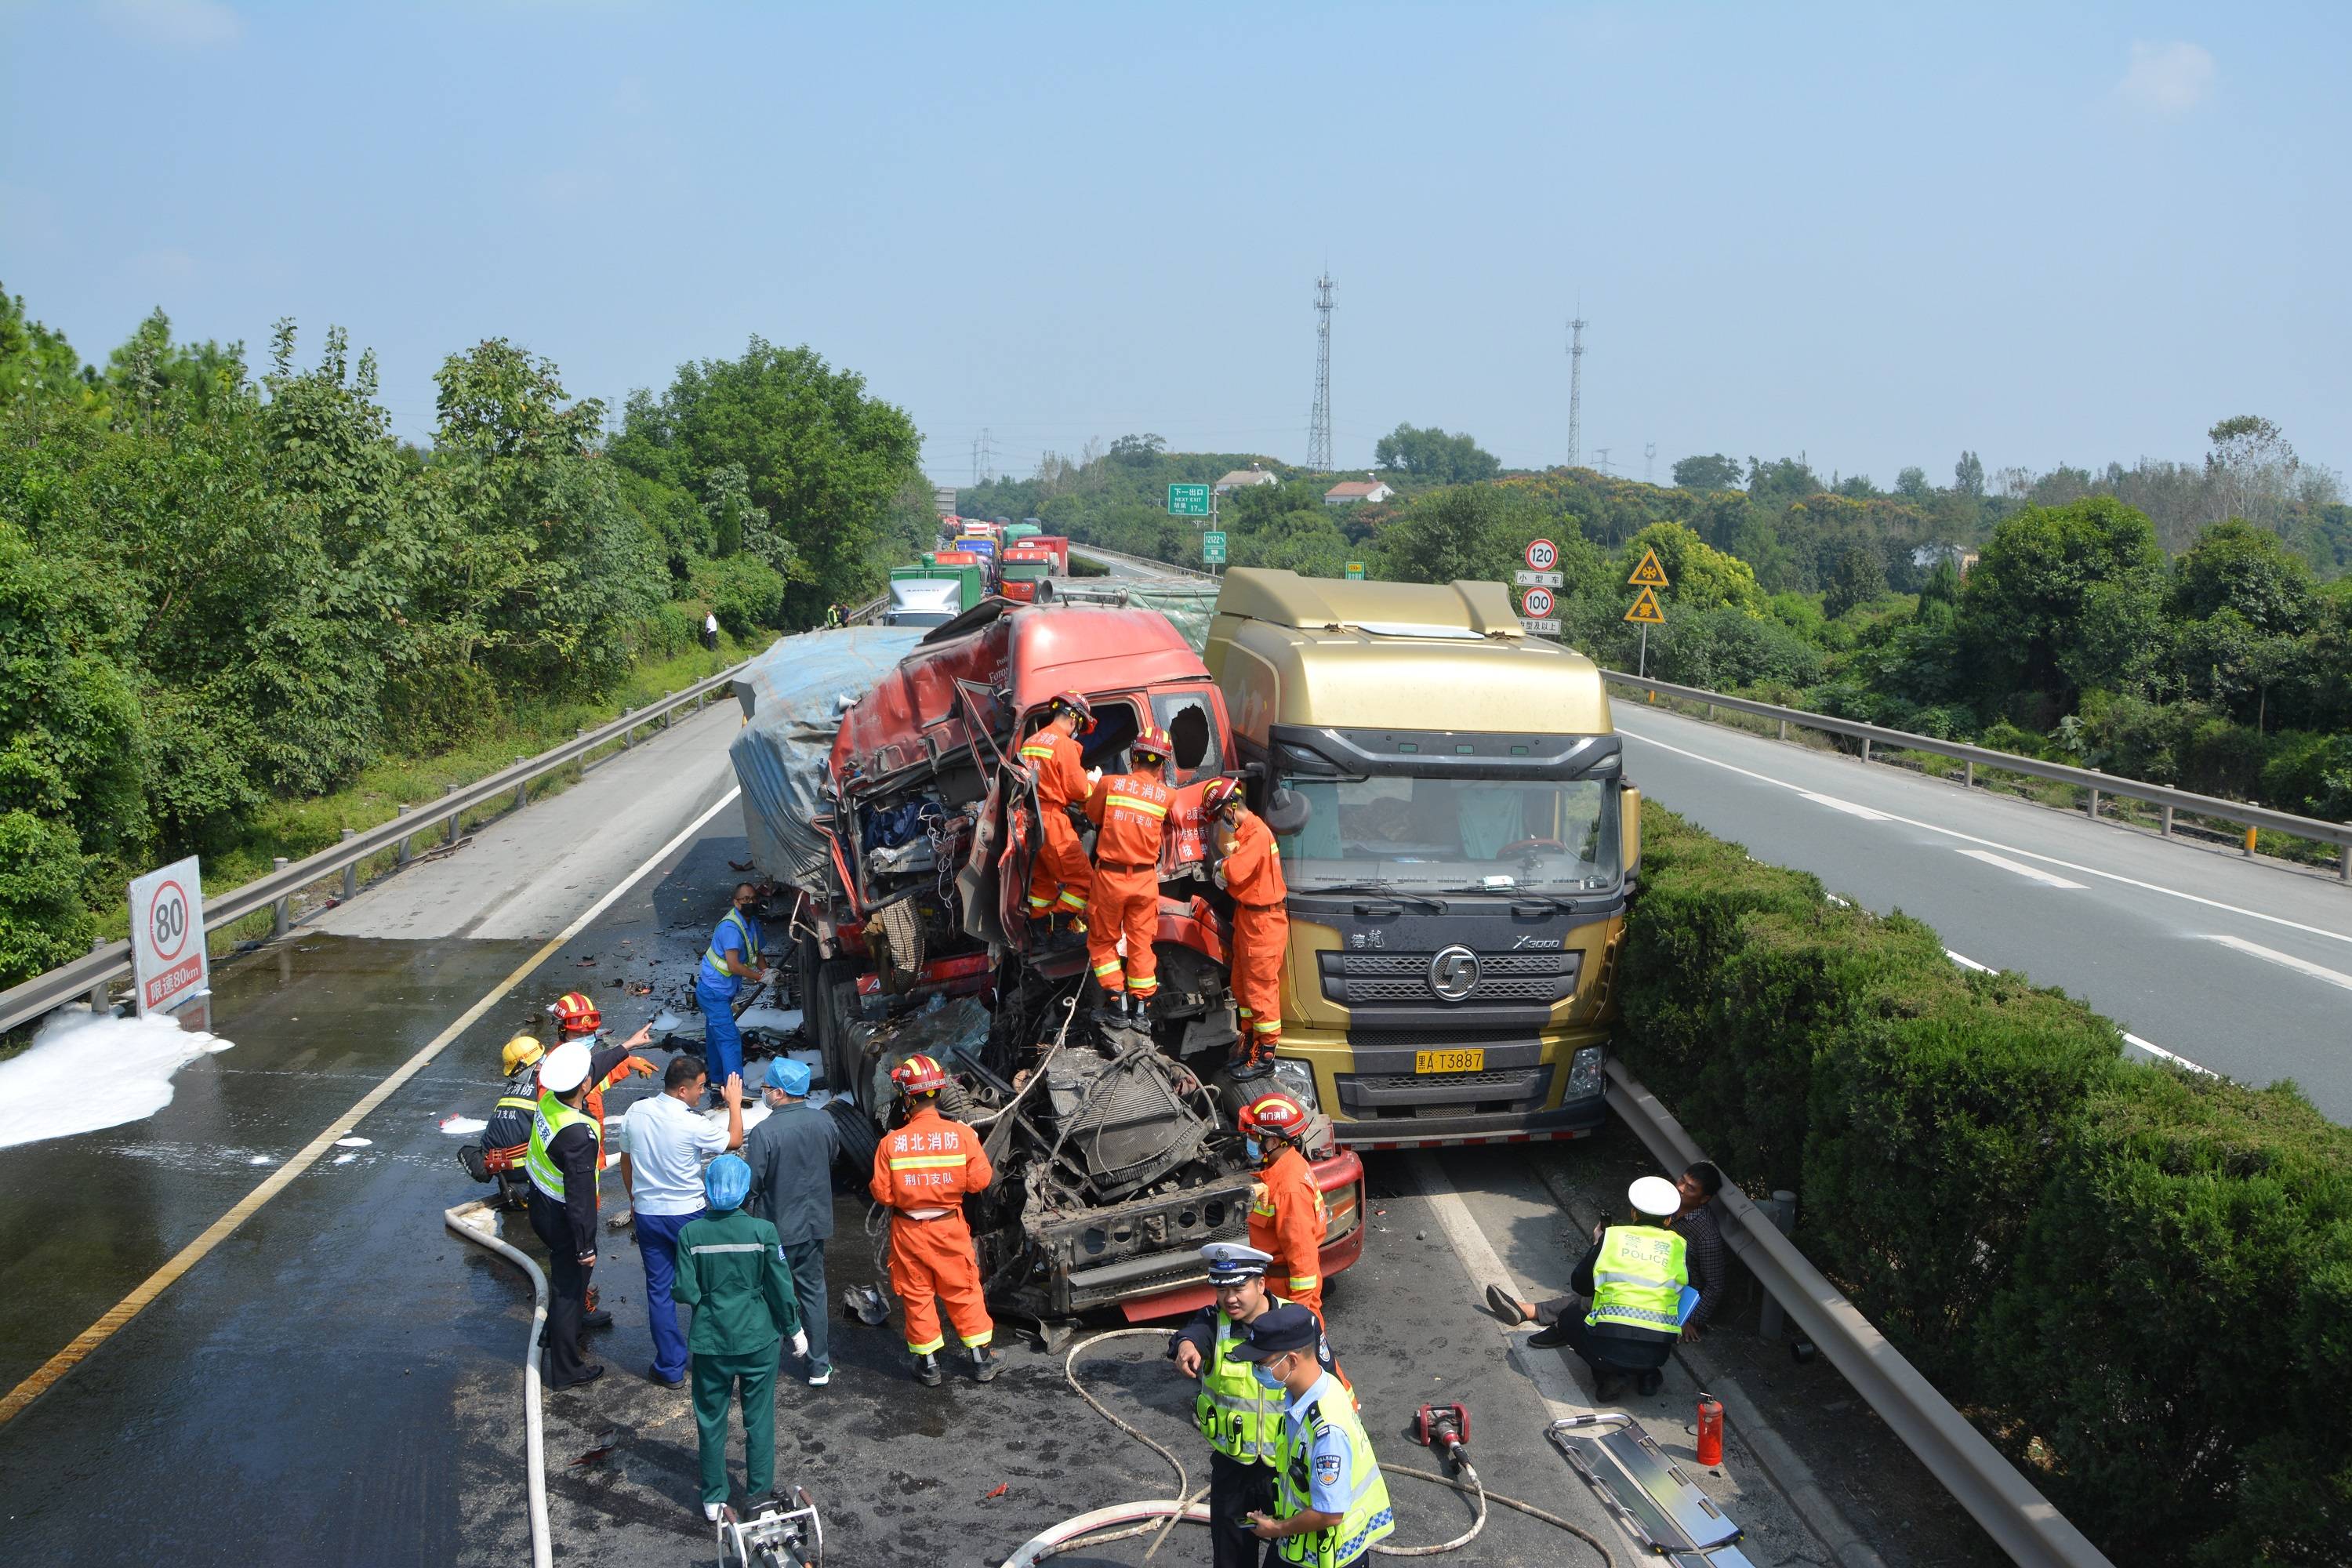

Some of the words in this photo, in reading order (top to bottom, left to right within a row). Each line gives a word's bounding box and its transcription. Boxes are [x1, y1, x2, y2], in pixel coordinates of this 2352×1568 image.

[1174, 488, 1203, 496] 下一出口
[1206, 535, 1220, 544] 12122
[1532, 548, 1552, 563] 120
[1519, 573, 1559, 585] 小型车
[1529, 595, 1549, 610] 100
[1113, 777, 1167, 804] 湖北消防
[1113, 809, 1153, 828] 荆门支队
[156, 898, 183, 943] 80
[1512, 935, 1560, 949] X3000
[1260, 1111, 1287, 1120] 荆门消防
[894, 1132, 959, 1152] 湖北消防
[904, 1173, 953, 1186] 荆门支队
[1621, 1247, 1669, 1268] POLICE
